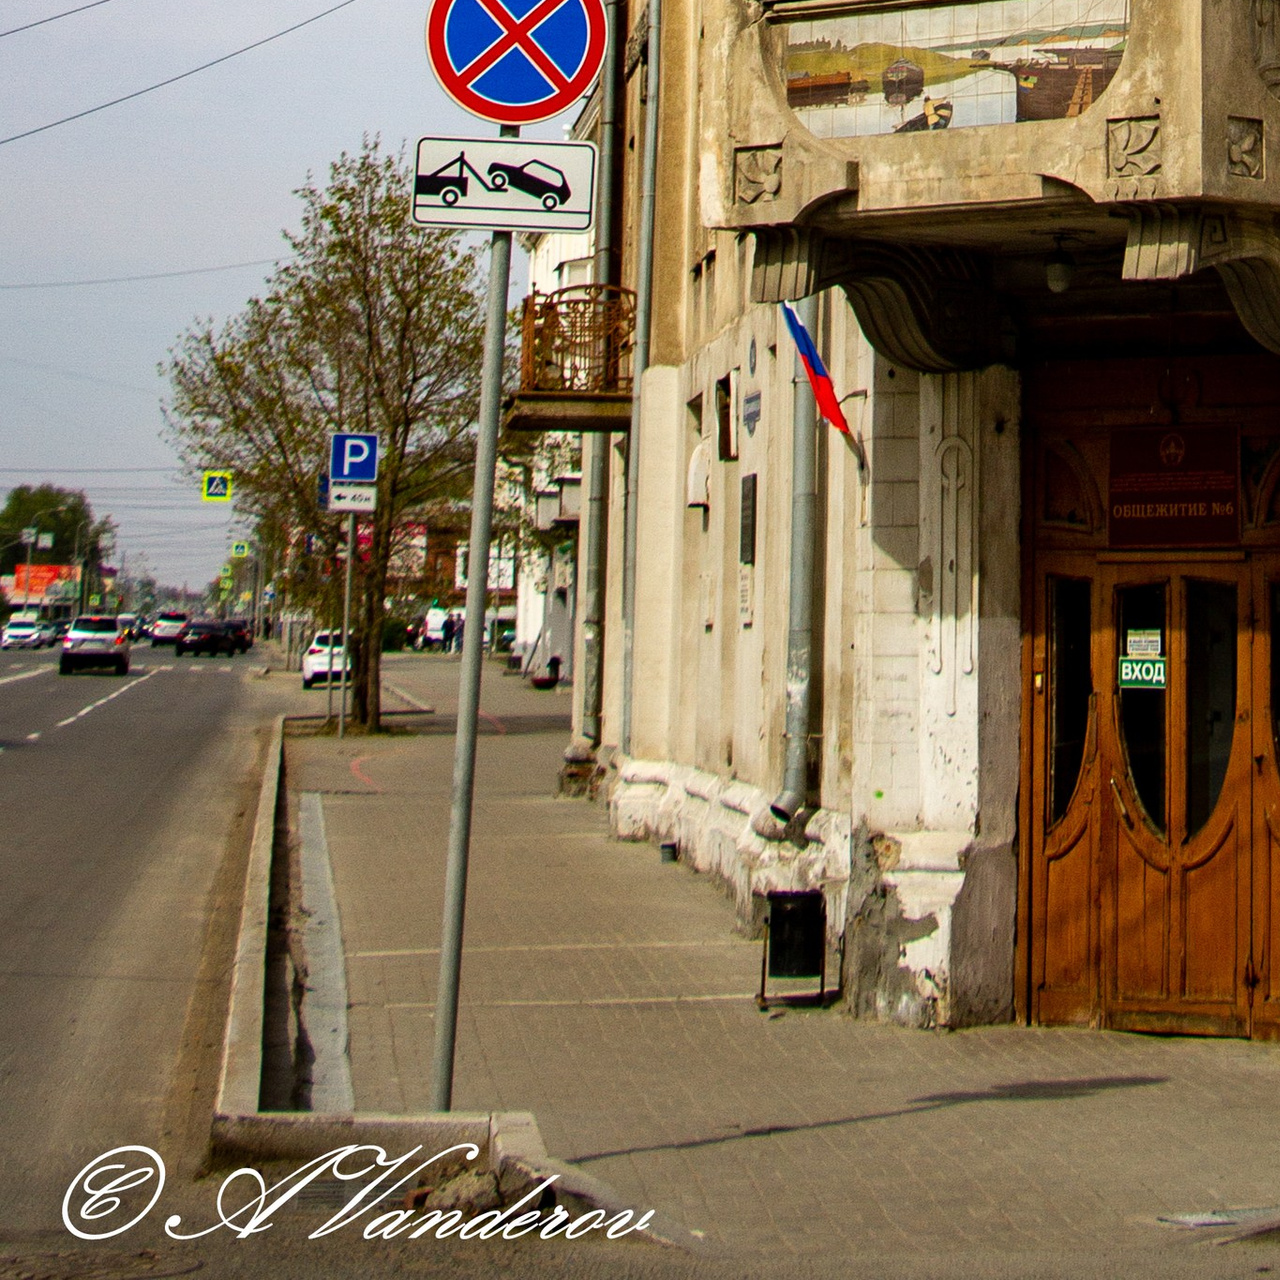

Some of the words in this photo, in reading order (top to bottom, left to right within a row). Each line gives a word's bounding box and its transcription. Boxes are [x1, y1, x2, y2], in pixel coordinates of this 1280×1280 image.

[343, 439, 370, 475] P
[1112, 503, 1207, 518] ОБЩЕЖИТИЕ
[1211, 502, 1234, 515] №6
[1121, 661, 1166, 684] ВХОД
